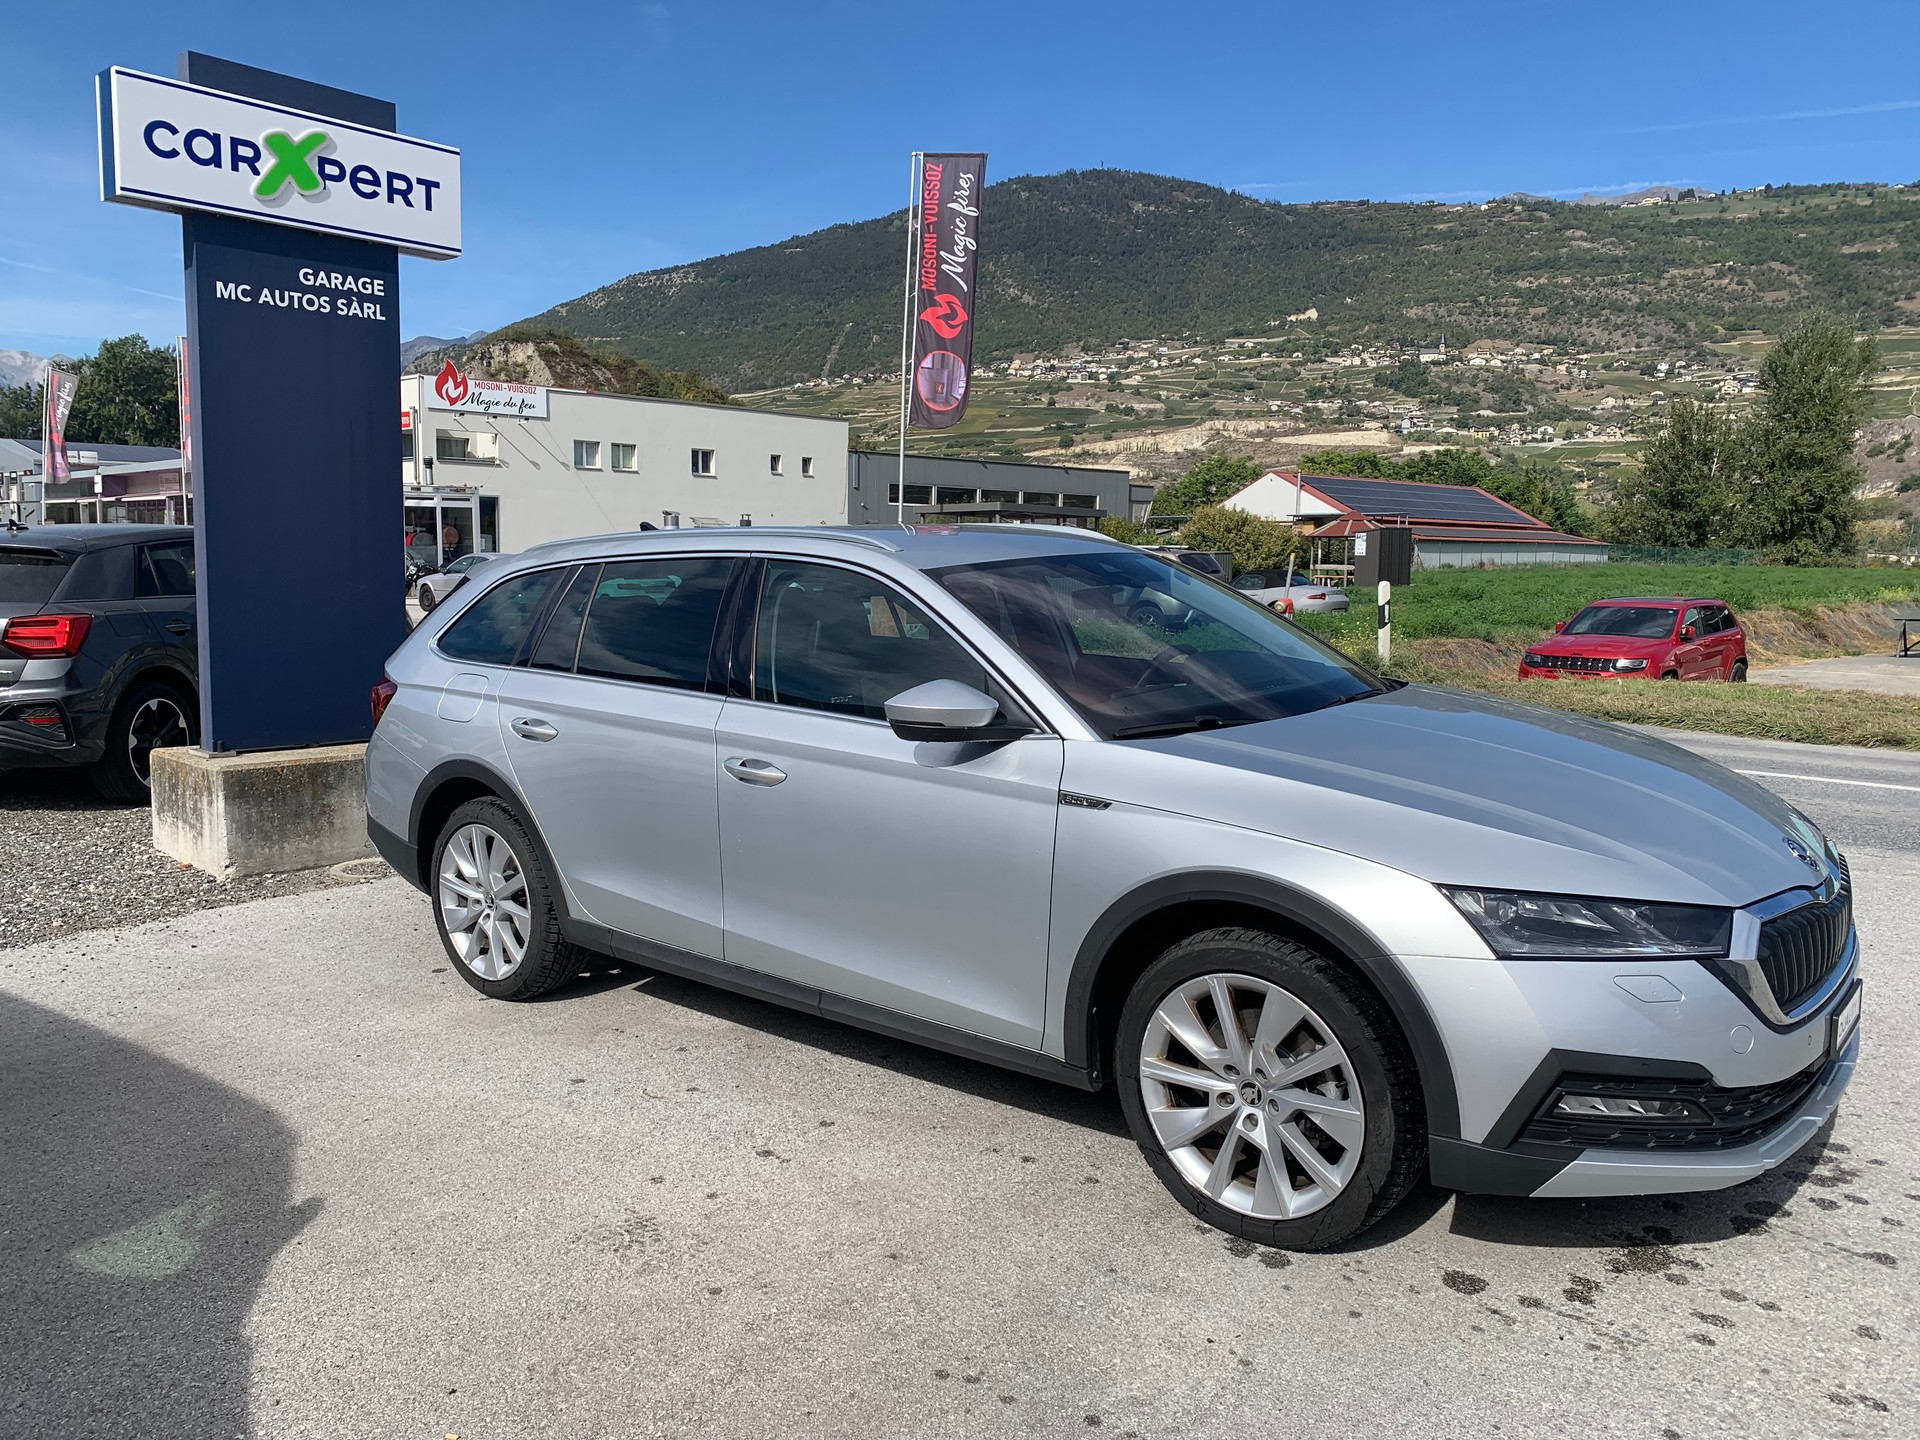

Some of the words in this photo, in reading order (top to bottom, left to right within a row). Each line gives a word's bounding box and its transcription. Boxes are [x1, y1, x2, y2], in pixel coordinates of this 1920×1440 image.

[947, 171, 979, 217] fires
[920, 163, 943, 291] MOSONI-VUISSOZ
[939, 217, 977, 293] Magic
[215, 280, 252, 302] MC
[258, 288, 331, 313] AUTOS
[336, 296, 386, 321] SÀRL
[299, 268, 385, 296] GARAGE
[461, 391, 501, 411] Magie
[503, 396, 518, 408] du
[518, 398, 536, 414] feu
[474, 381, 537, 395] MOSONI-VUISSOZ
